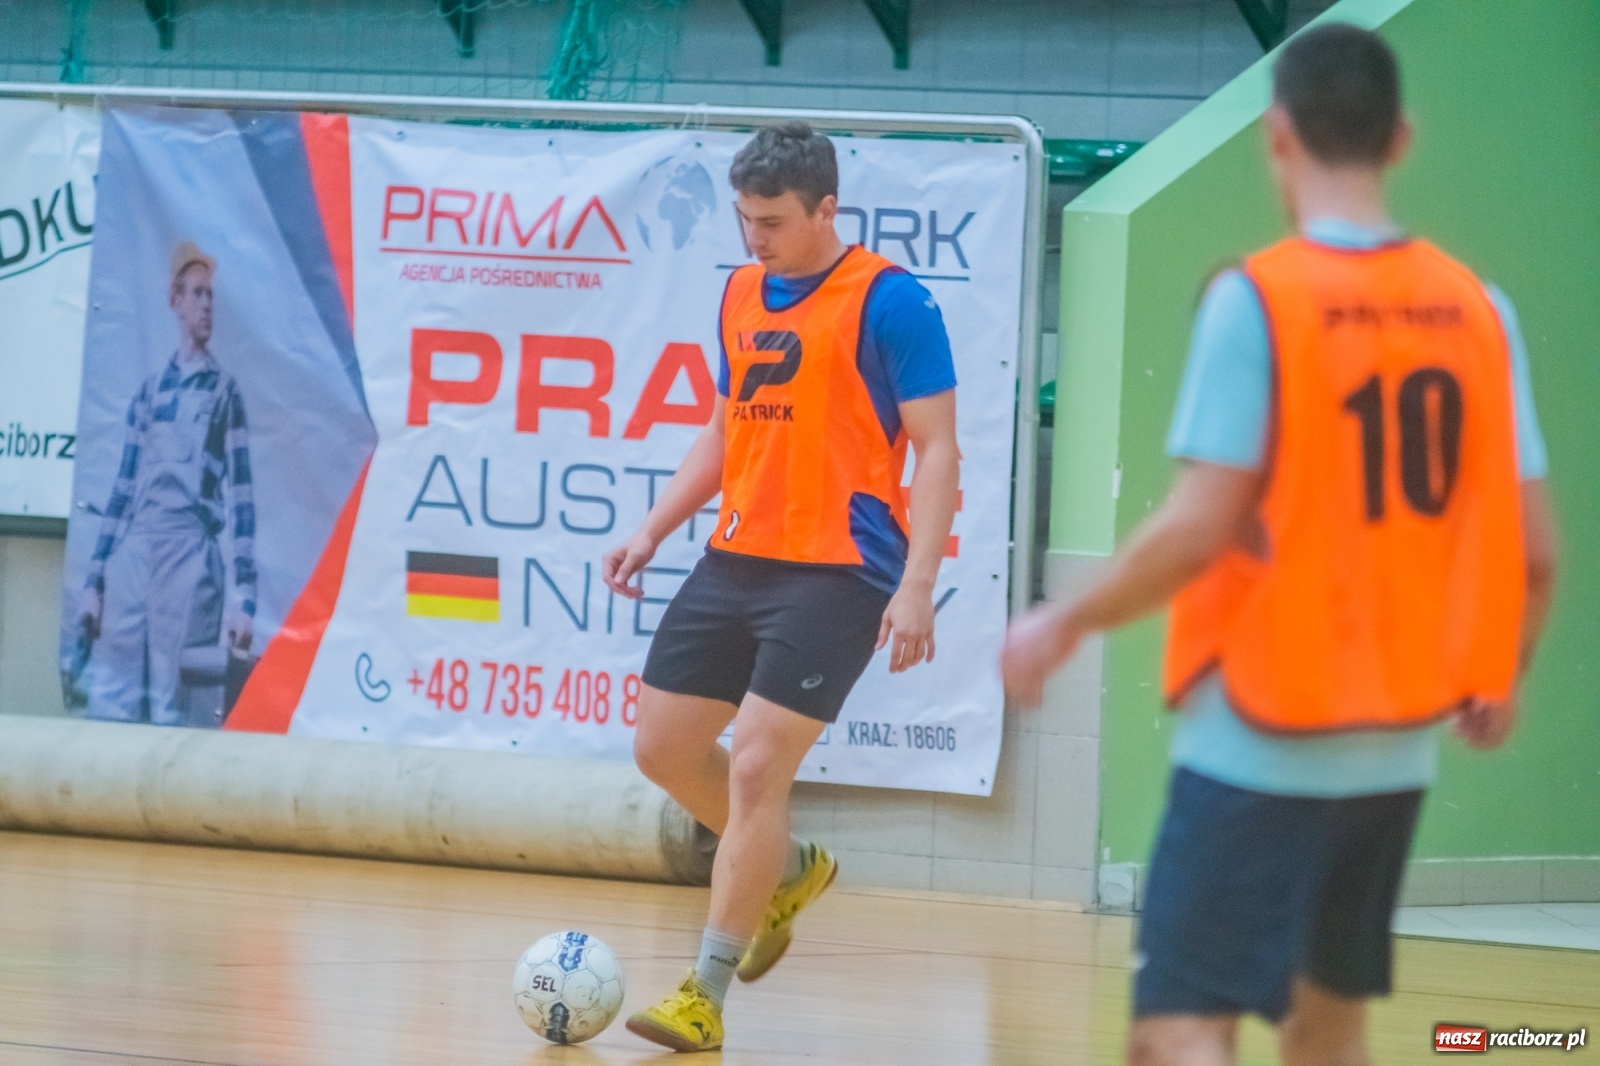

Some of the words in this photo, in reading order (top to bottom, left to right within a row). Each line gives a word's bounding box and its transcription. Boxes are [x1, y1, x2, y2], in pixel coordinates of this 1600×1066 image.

[380, 184, 627, 252] PRIMA
[400, 264, 465, 284] AGENCJA
[469, 263, 603, 290] POŚREDNICTWA
[407, 327, 717, 441] PRA
[733, 404, 795, 422] PATRICK
[1342, 366, 1464, 524] 10
[406, 658, 470, 712] +48
[480, 661, 543, 719] 735
[553, 668, 611, 726] 408
[848, 721, 899, 748] KRAZ:
[904, 724, 957, 751] 18606
[532, 975, 558, 993] SEL
